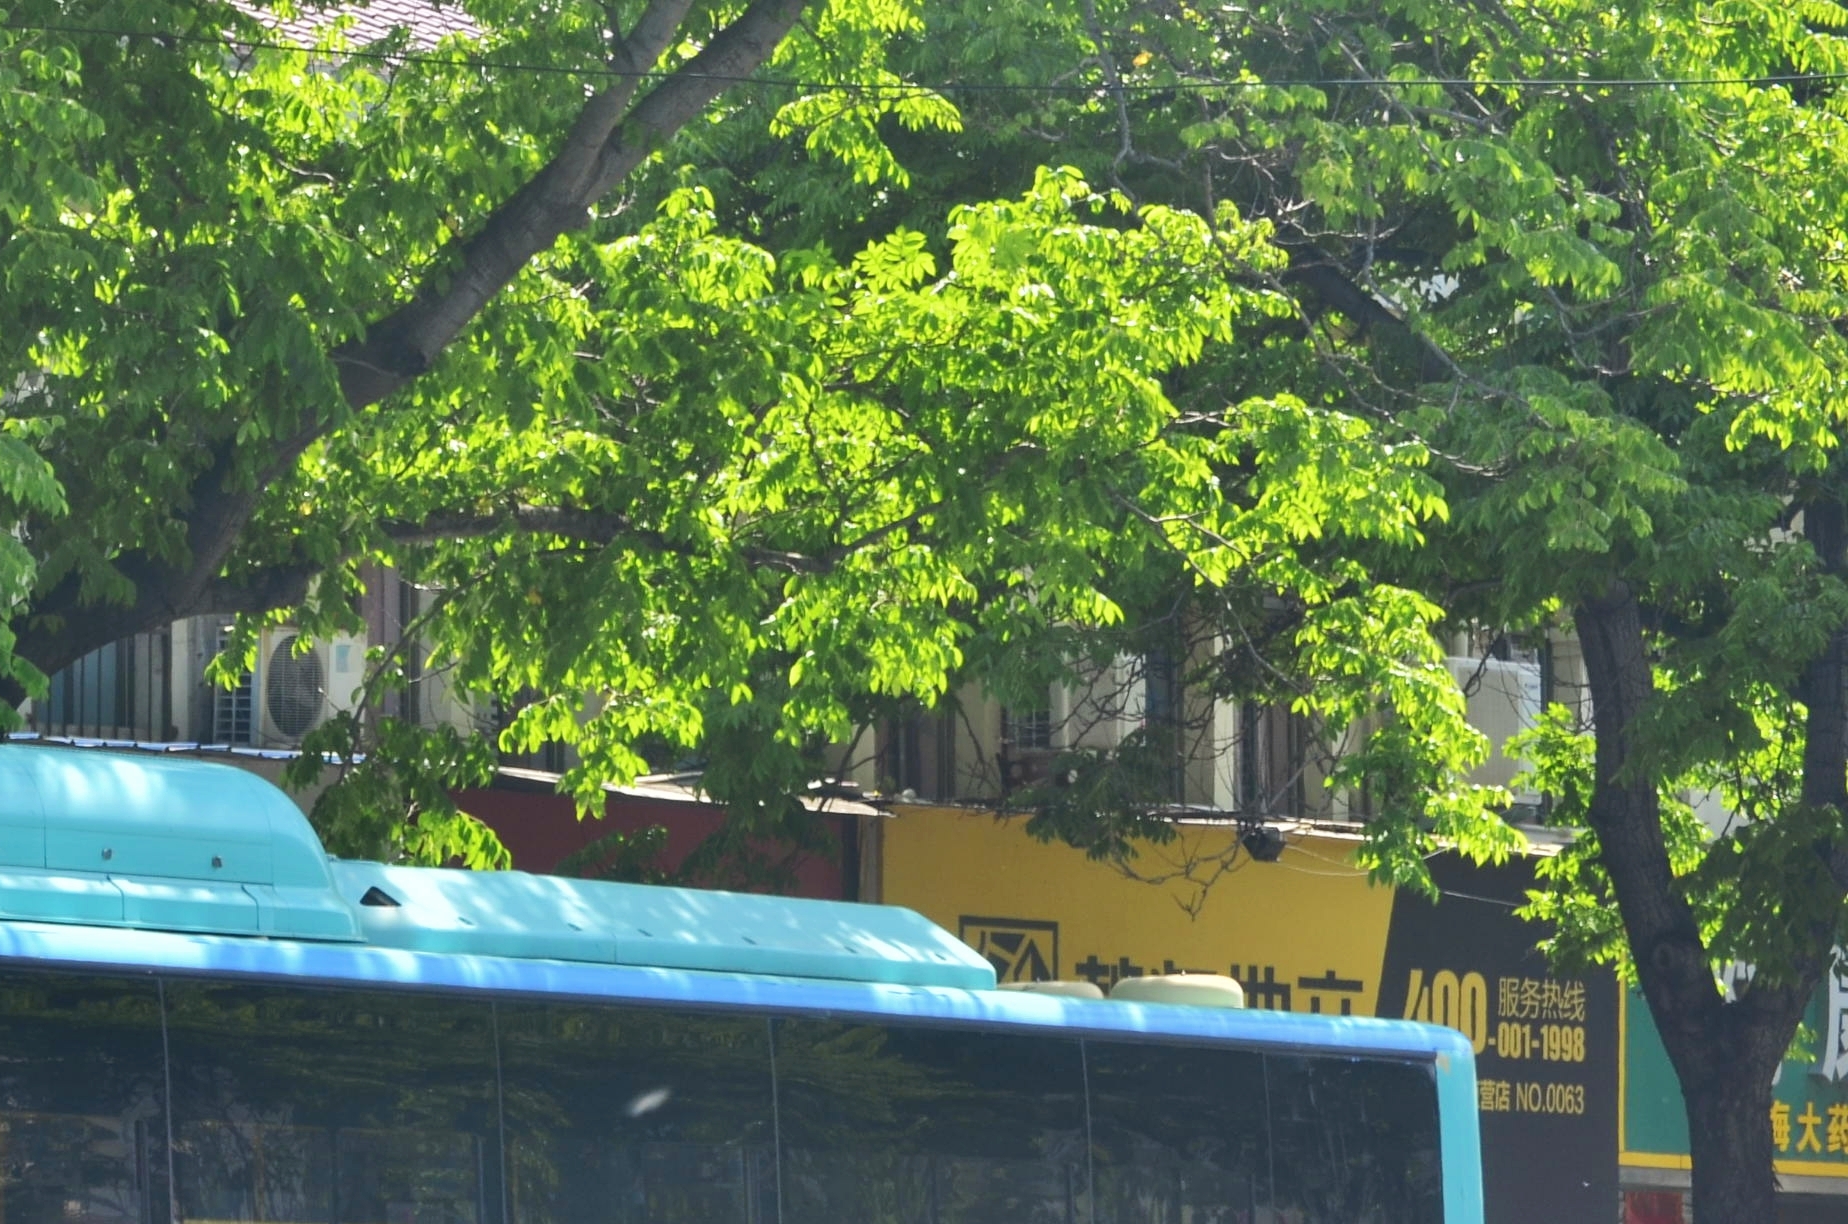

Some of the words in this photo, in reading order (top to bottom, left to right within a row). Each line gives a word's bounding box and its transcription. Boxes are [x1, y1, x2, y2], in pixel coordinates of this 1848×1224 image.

[1498, 975, 1586, 1022] 服务热线
[1477, 1079, 1511, 1113] 营店
[1516, 1082, 1585, 1115] NO.0063
